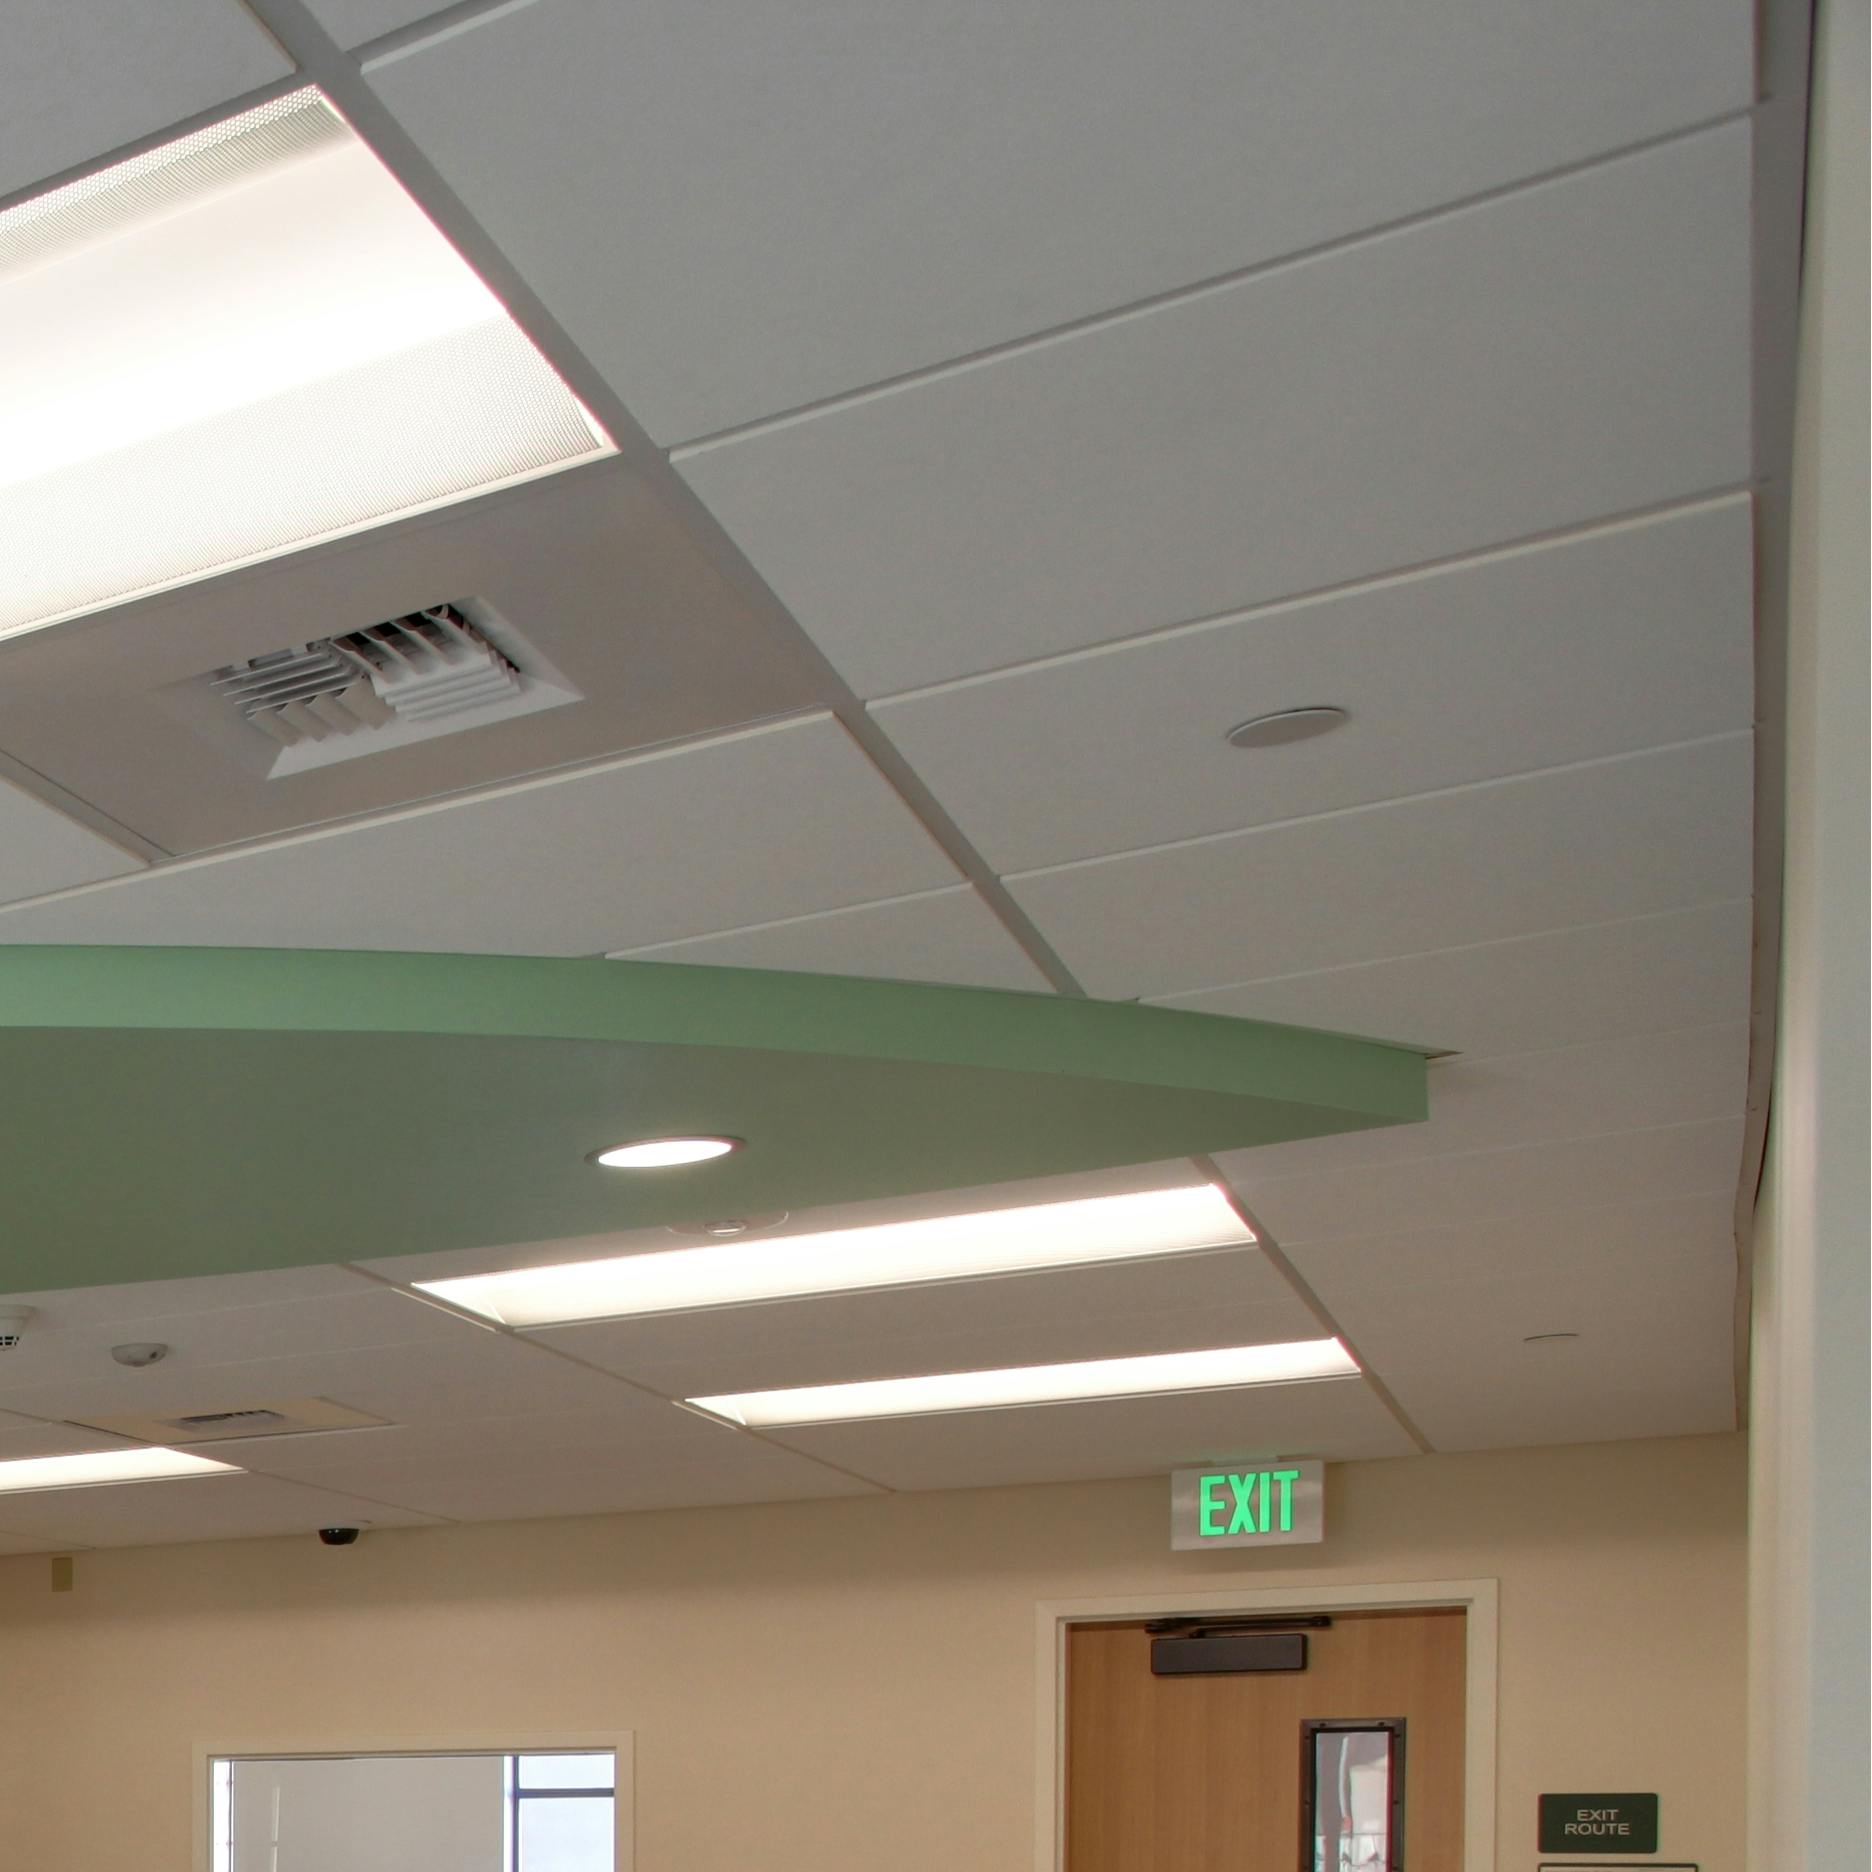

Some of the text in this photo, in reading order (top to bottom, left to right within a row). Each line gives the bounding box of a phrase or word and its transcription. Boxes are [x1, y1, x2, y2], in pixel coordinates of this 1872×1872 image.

[1199, 1470, 1299, 1536] EXIT
[1576, 1809, 1619, 1822] EXIT
[1564, 1823, 1631, 1835] ROUTE
